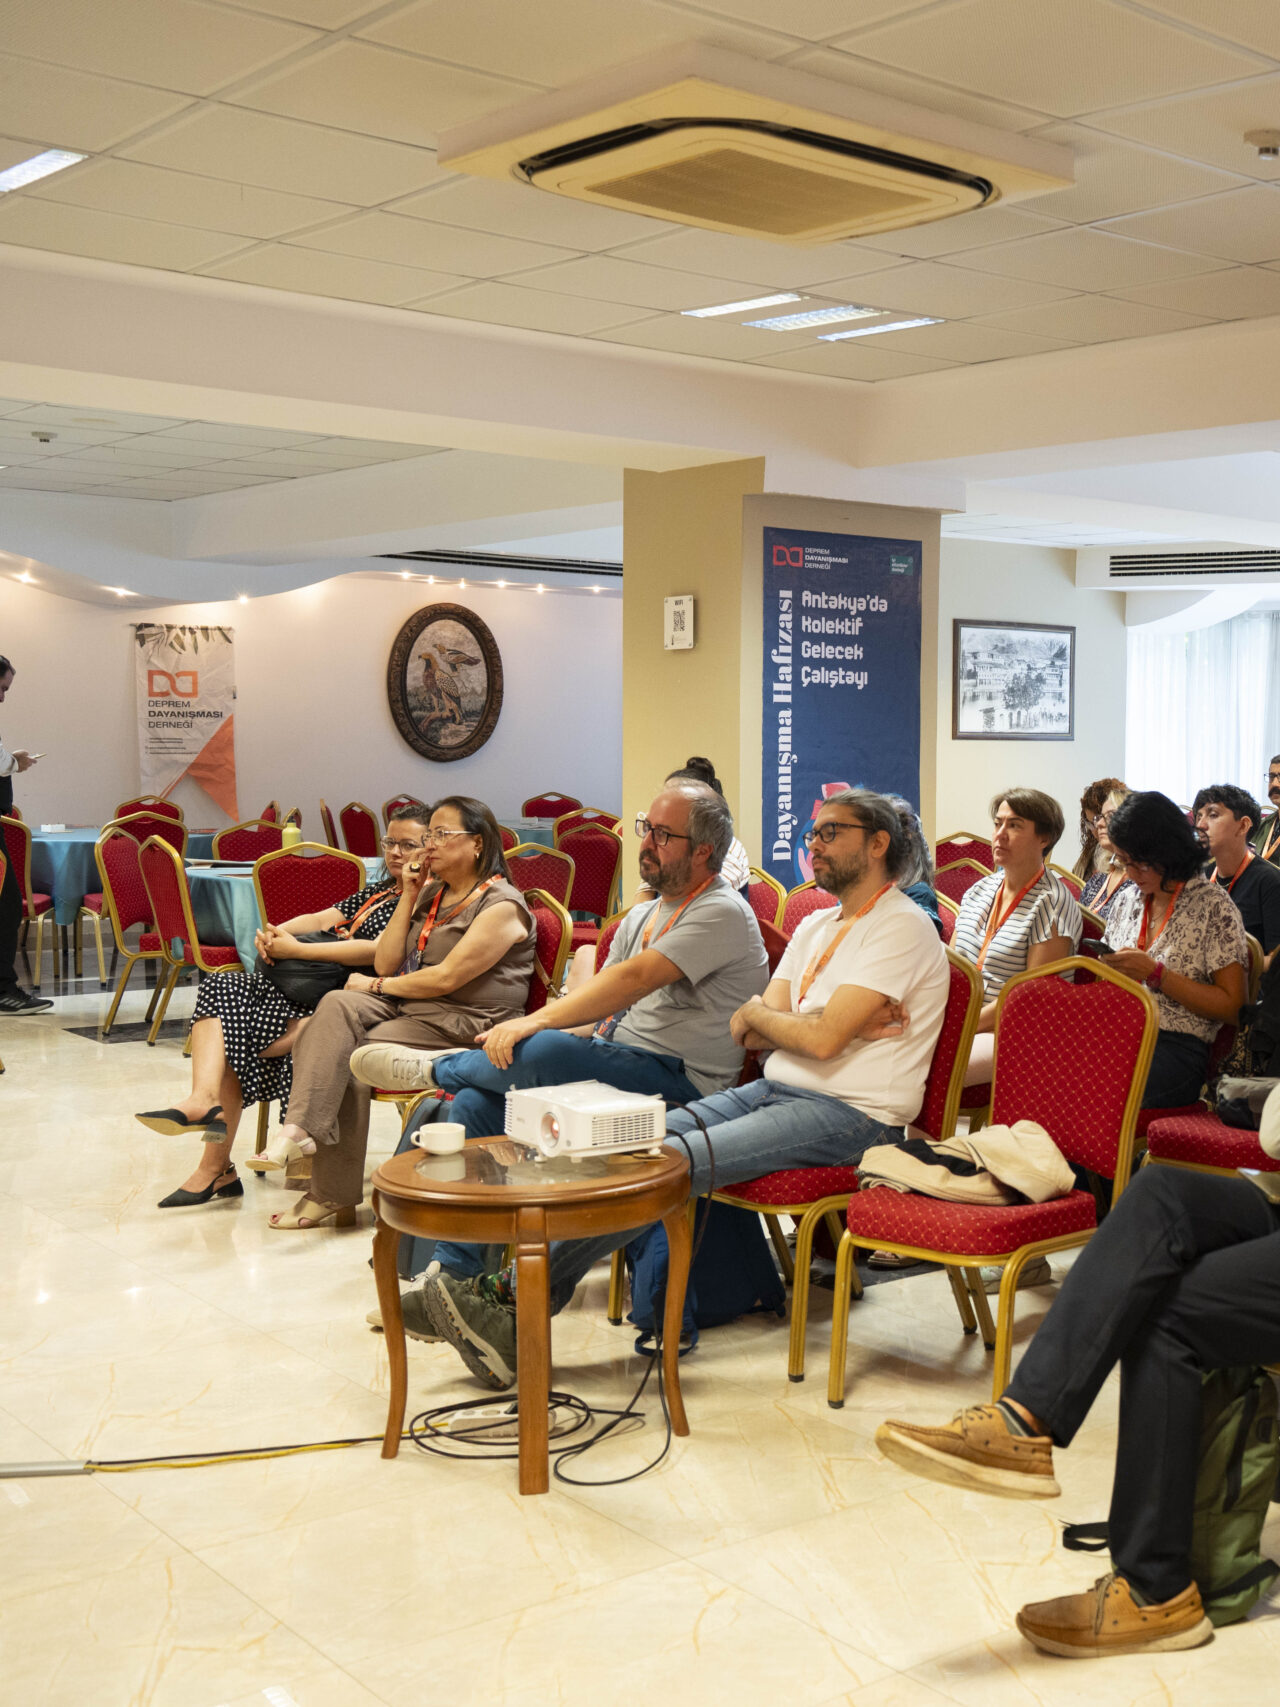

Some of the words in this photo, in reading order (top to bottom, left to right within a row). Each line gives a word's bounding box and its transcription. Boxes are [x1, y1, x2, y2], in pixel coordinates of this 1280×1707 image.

[804, 554, 848, 563] DAYANIŞMASI
[804, 562, 830, 570] DERNEĞİ
[801, 615, 864, 635] Kolektif
[771, 589, 793, 704] Hafızası
[801, 640, 864, 660] Gelecek
[801, 665, 868, 690] Çalıştayı
[147, 700, 191, 708] DEPREM
[147, 710, 223, 719] DAYANIŞMASI
[147, 719, 193, 729] DERNEĞİ
[772, 708, 798, 861] Dayanışma
